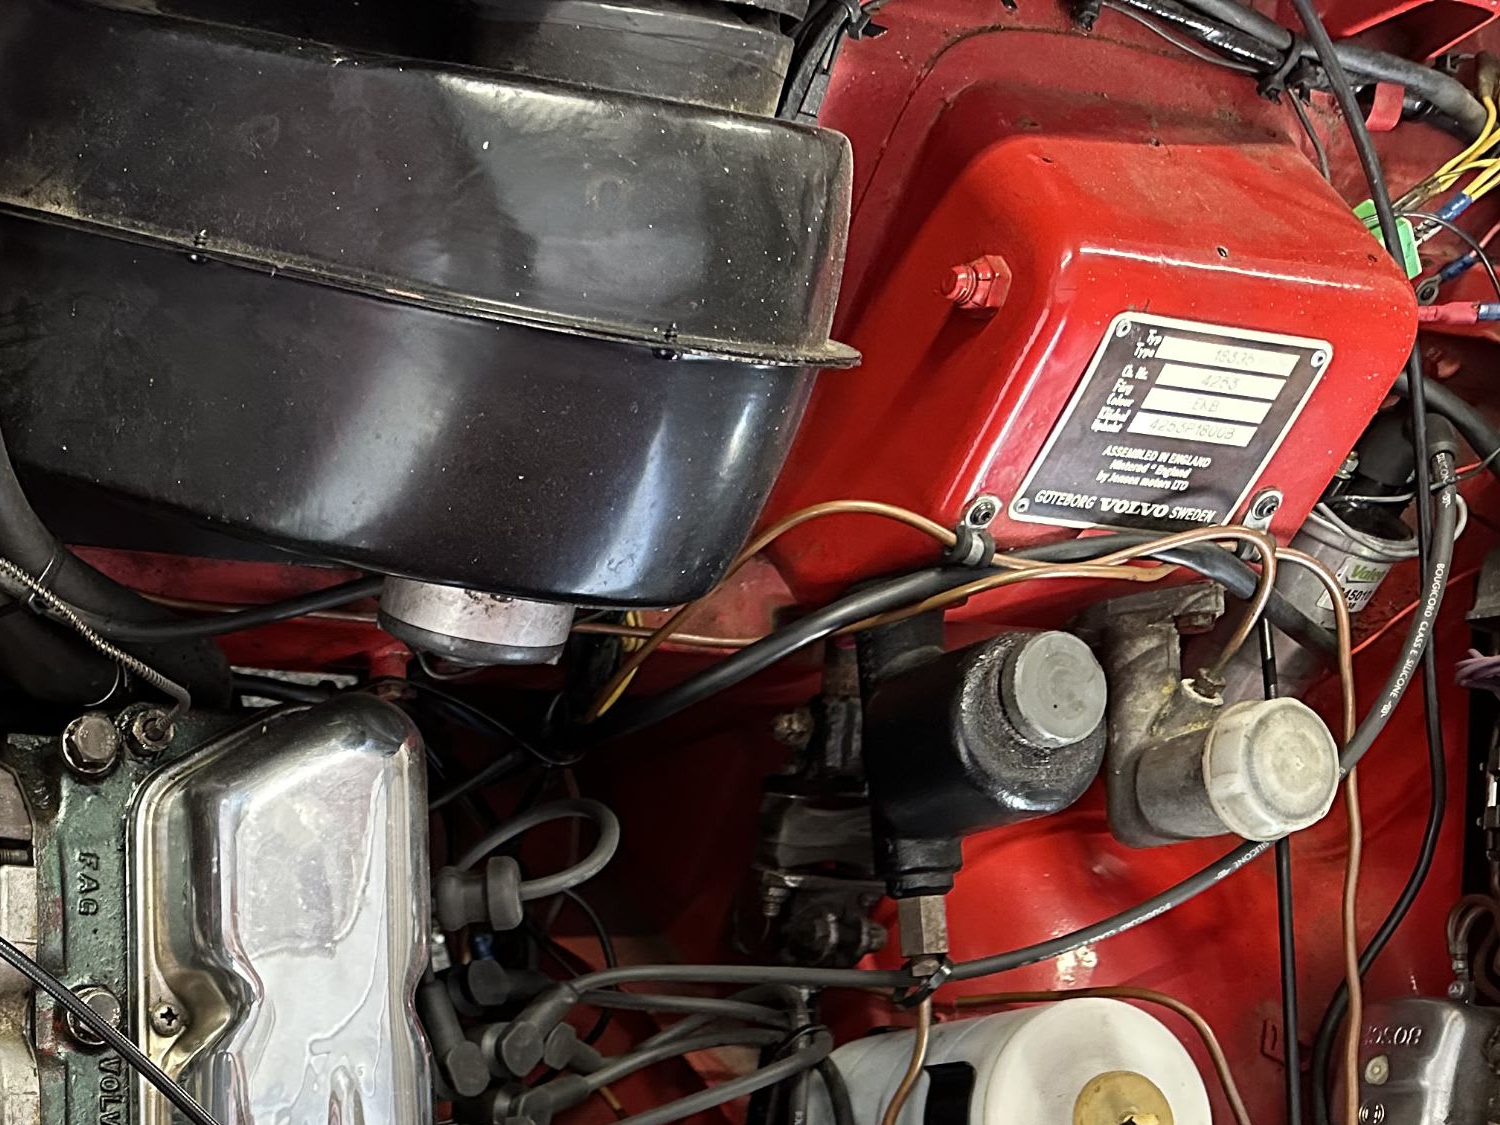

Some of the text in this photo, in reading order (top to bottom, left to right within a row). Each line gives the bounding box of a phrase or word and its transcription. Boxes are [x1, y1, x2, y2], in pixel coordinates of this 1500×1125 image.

[1102, 445, 1212, 468] ASSEMBLED IN ENGLAND
[1100, 497, 1170, 518] VOLVO
[1168, 506, 1216, 523] SWEDEN
[1424, 563, 1446, 618] BOUGICORD
[1412, 621, 1429, 648] CLASS
[1390, 658, 1414, 698] SILICONE
